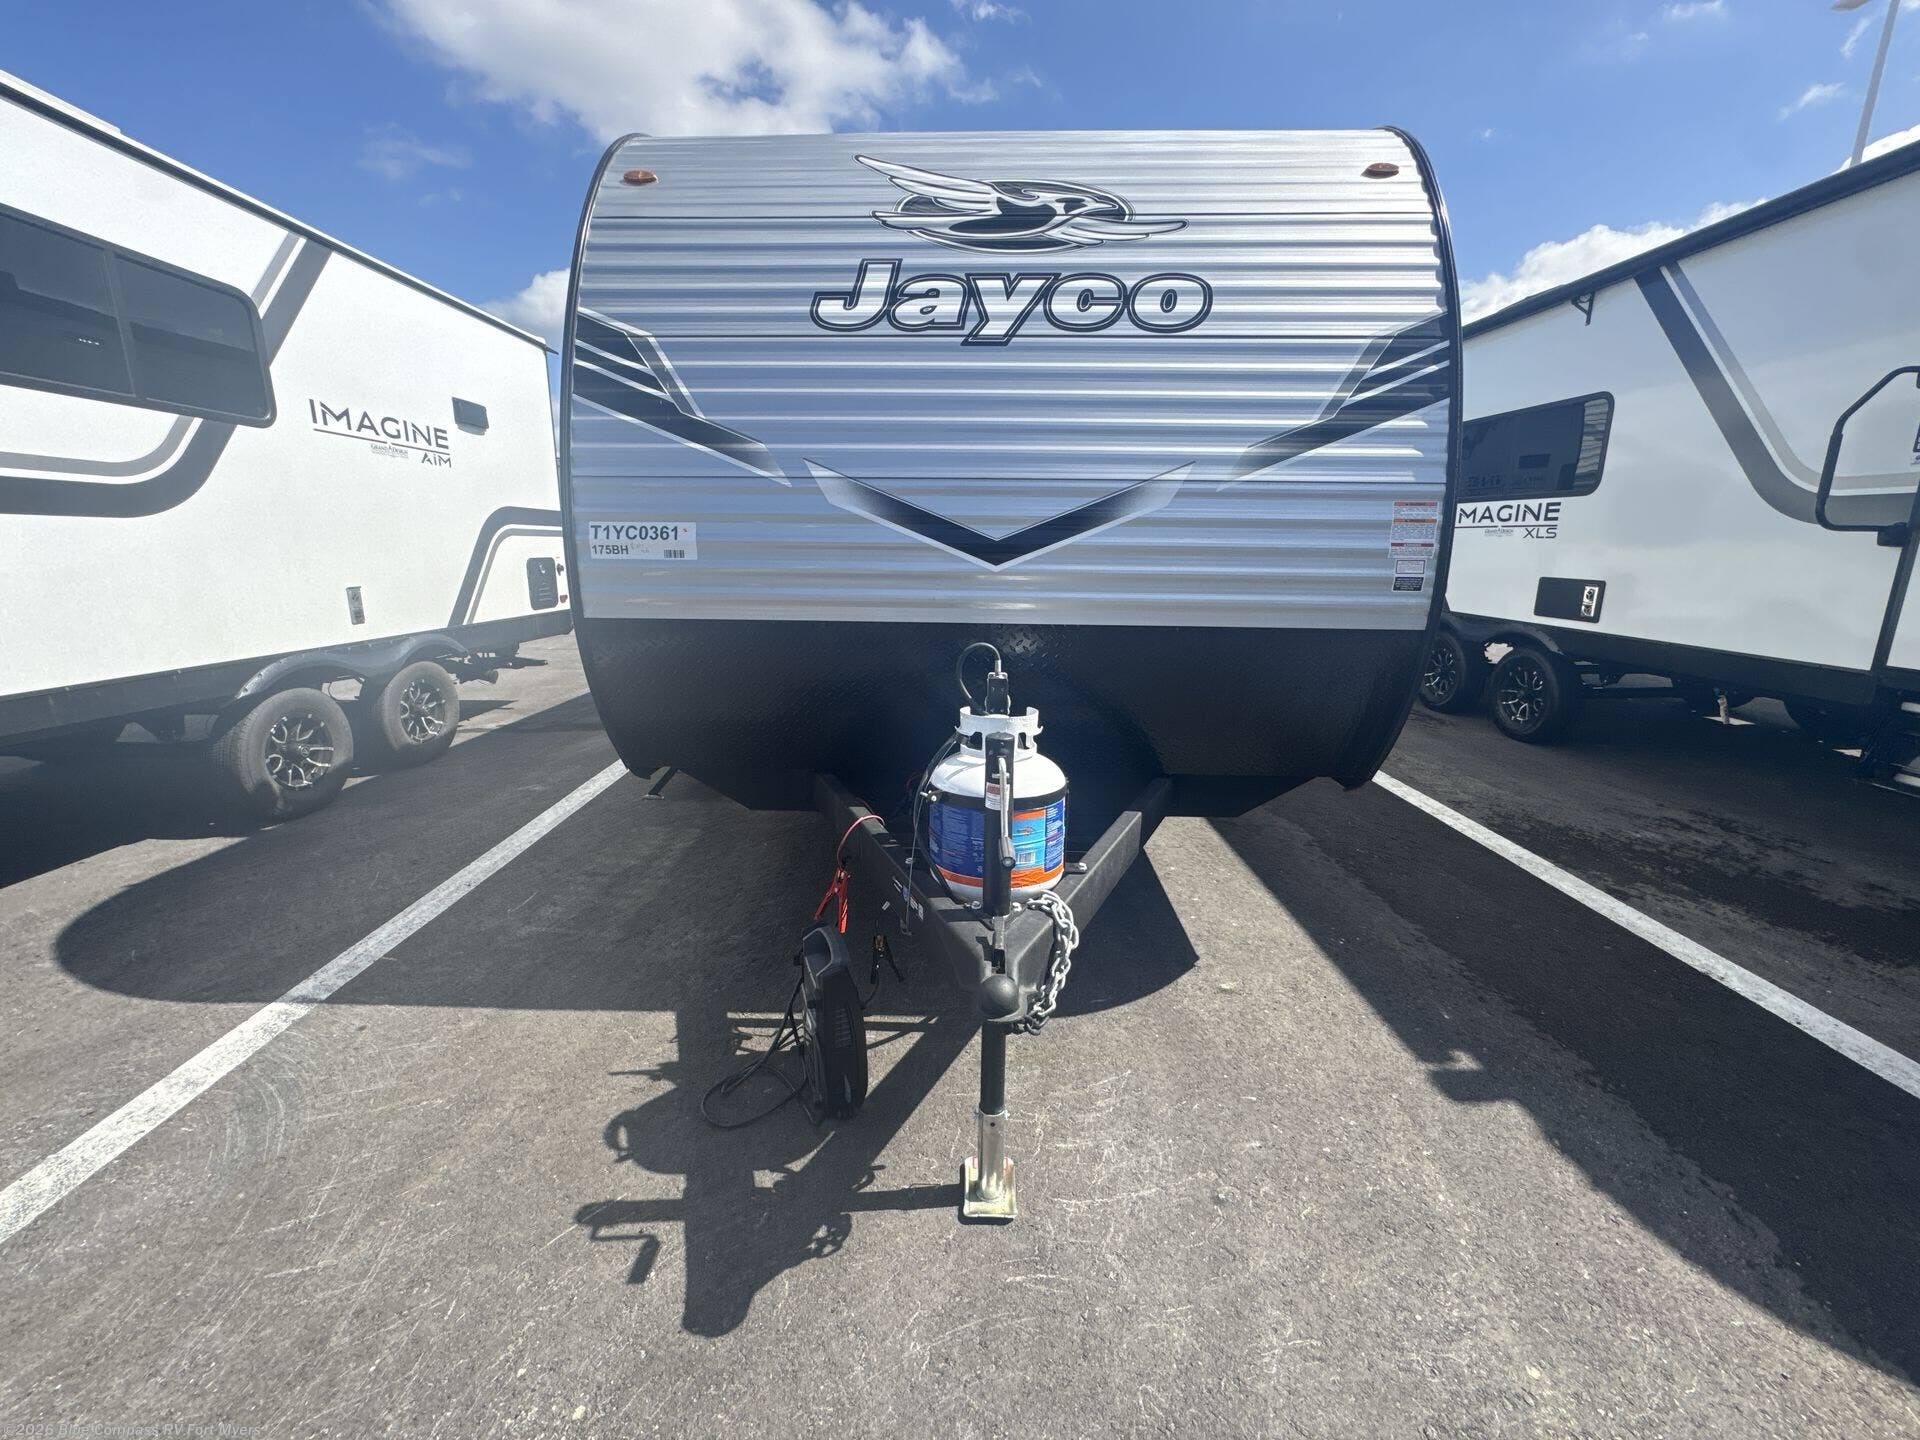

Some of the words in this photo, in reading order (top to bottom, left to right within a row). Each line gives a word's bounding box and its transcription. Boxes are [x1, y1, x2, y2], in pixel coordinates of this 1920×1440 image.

[809, 258, 1213, 346] Jayco
[309, 399, 449, 449] IMAGINE
[1458, 501, 1562, 524] MAGINE
[591, 525, 678, 541] T1YC0361
[1523, 527, 1558, 539] XLS
[592, 544, 629, 555] 175BH
